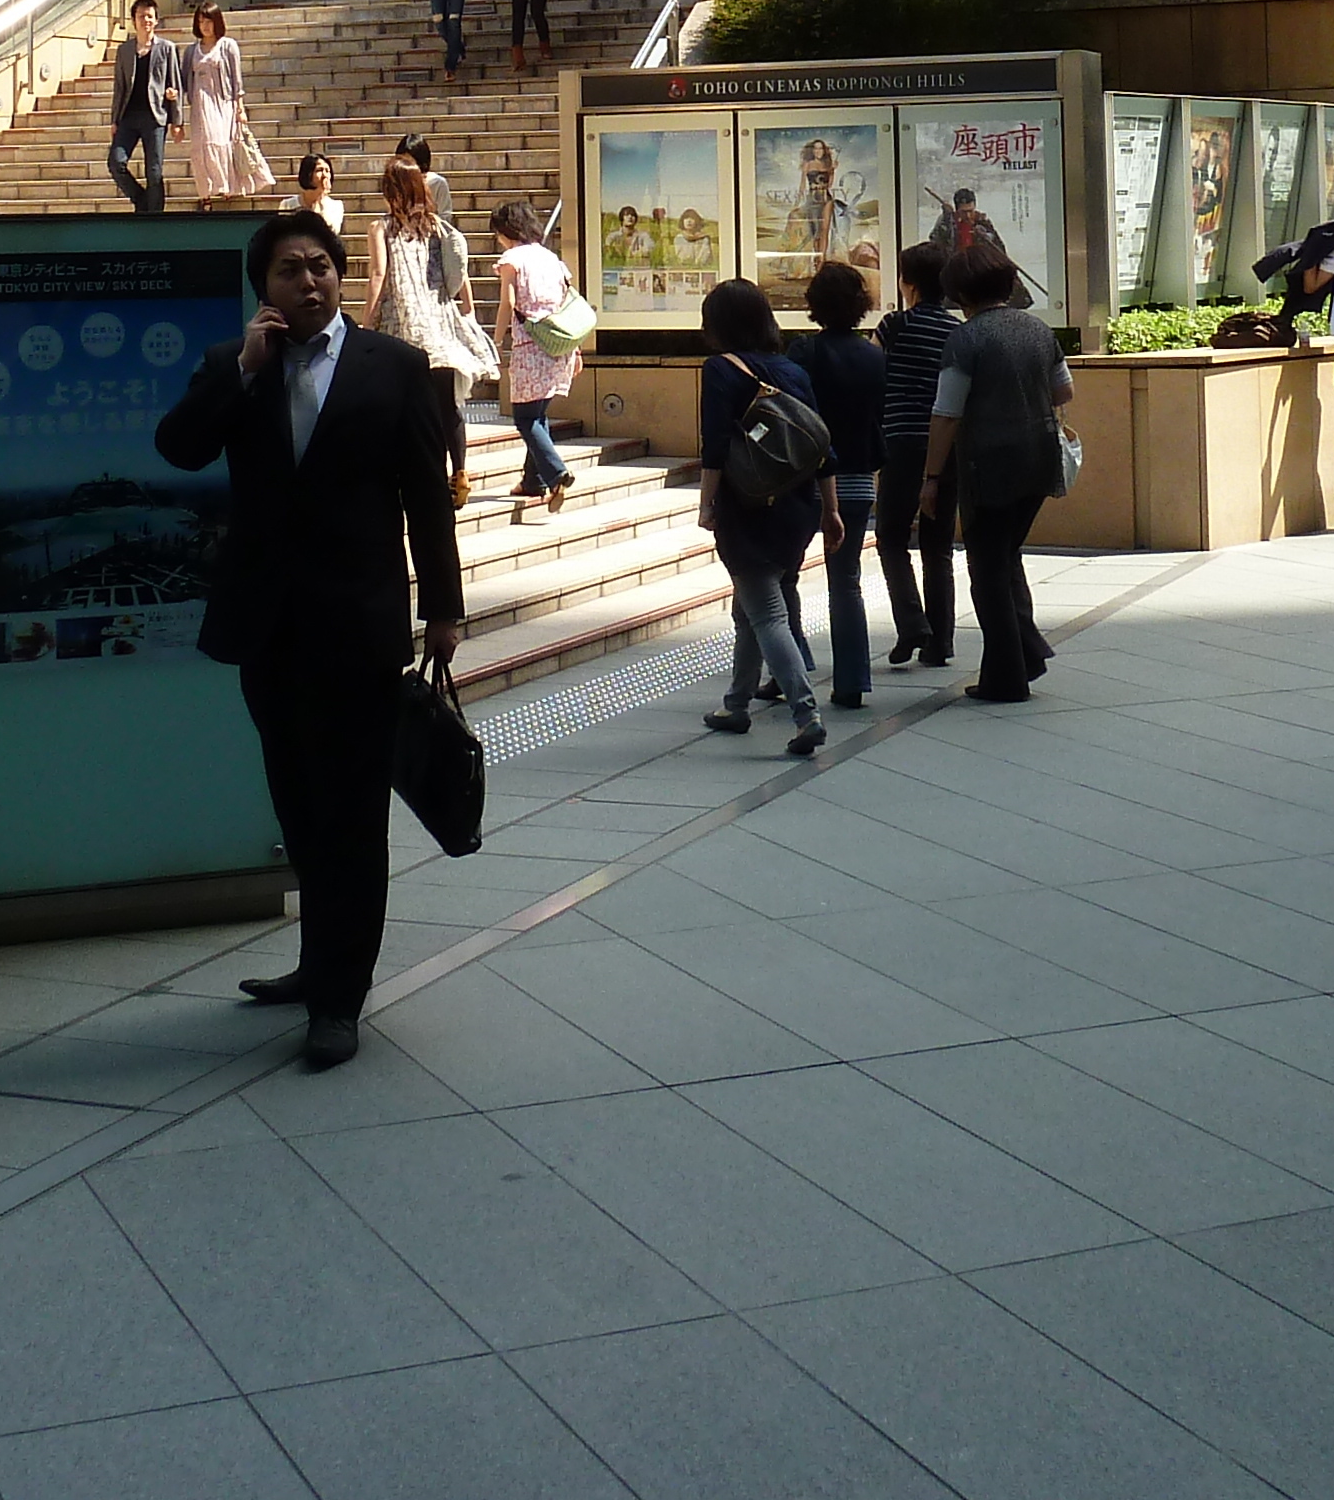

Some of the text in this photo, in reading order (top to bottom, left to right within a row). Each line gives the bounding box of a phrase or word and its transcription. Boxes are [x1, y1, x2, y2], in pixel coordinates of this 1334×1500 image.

[692, 72, 967, 96] TOHO CINEMAS ROPPONGI HILLS
[951, 122, 1041, 165] 座頭市
[766, 189, 792, 204] SEX
[101, 261, 171, 275] スカイデッキ
[42, 281, 70, 292] CITY
[140, 278, 173, 290] DECK
